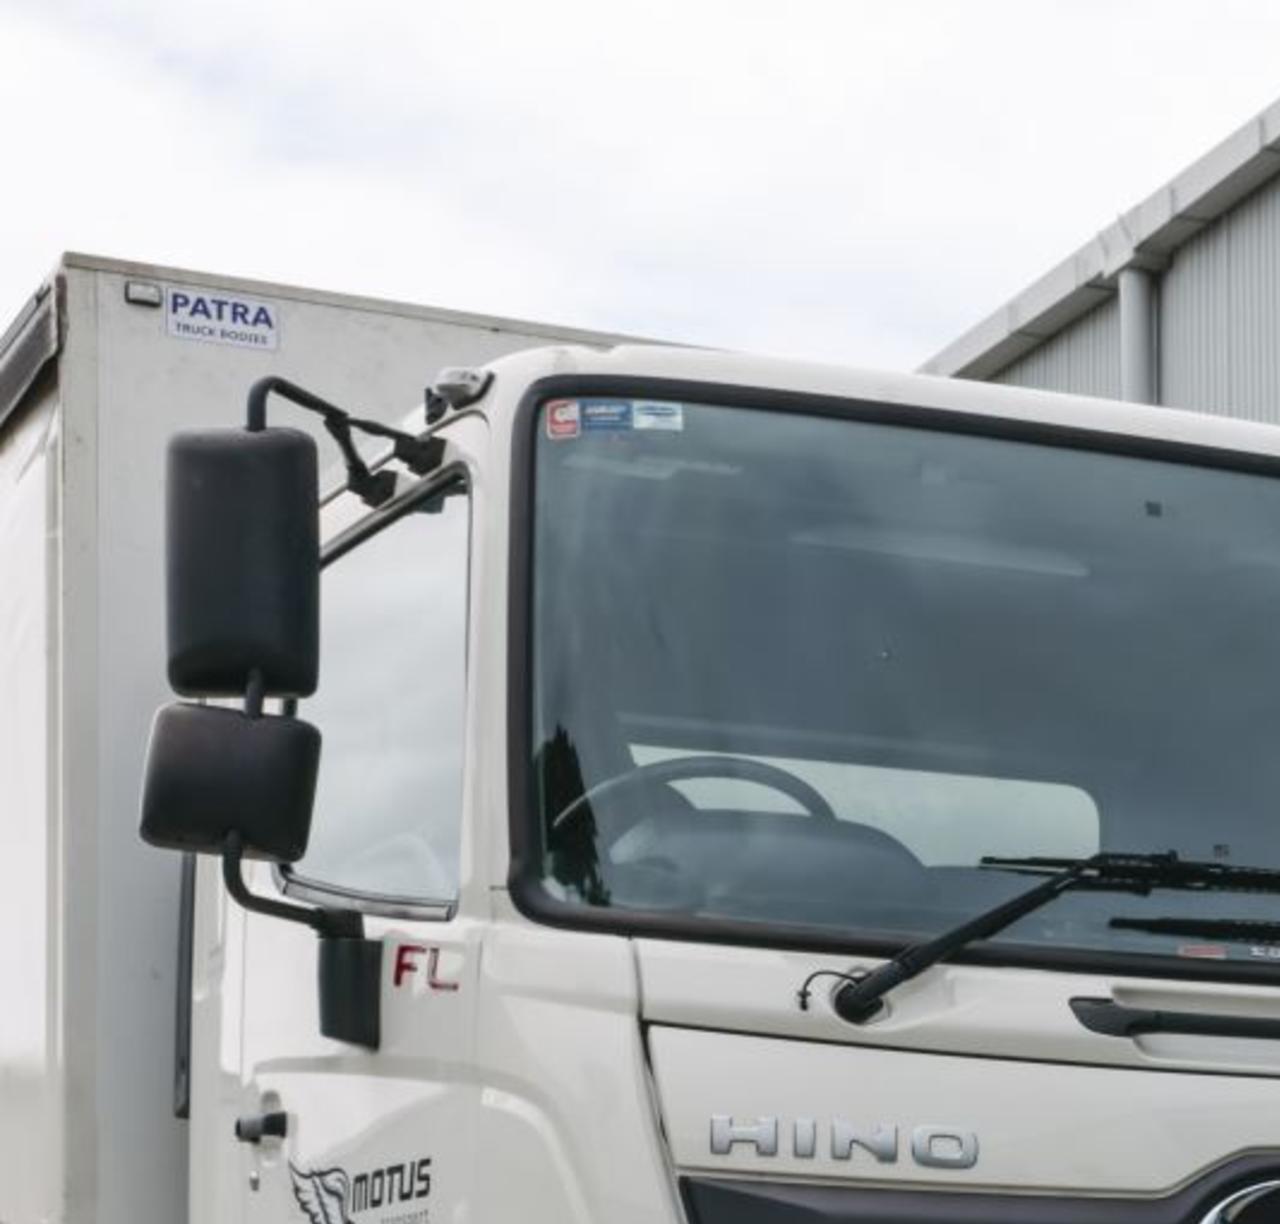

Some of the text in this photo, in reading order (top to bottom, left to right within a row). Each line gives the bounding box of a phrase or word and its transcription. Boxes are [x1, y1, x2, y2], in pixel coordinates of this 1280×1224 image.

[172, 293, 273, 329] PATRA
[176, 322, 268, 345] TRUCK BODIES
[394, 945, 459, 991] FL
[710, 1113, 979, 1169] HINO
[353, 1158, 431, 1213] MOTUS
